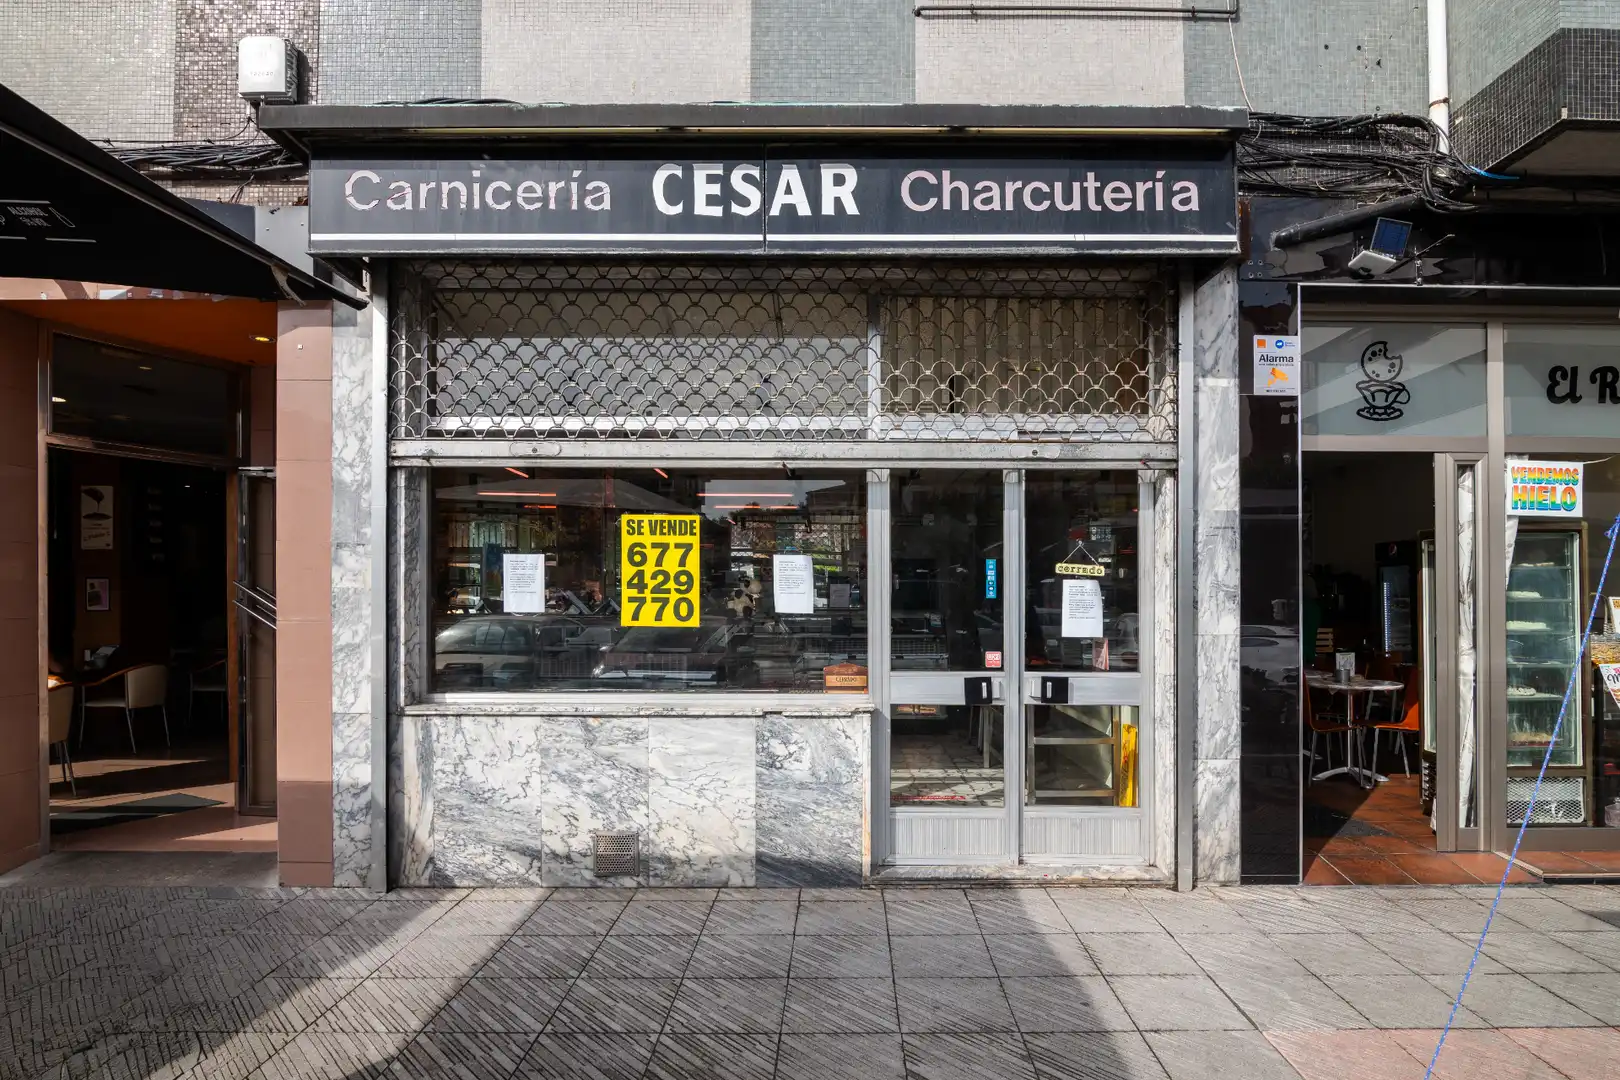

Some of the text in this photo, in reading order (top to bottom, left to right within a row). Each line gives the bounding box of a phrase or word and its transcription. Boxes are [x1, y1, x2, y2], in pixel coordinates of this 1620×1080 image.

[344, 162, 1200, 217] Carnicería CESAR Charcutería
[1258, 353, 1294, 363] Alarma
[1546, 365, 1583, 404] El
[1511, 466, 1579, 486] VENDEMOS
[1511, 485, 1577, 511] HIELO
[626, 519, 697, 536] SE VENDE
[627, 542, 694, 568] 677
[626, 569, 695, 595] 429
[1057, 565, 1103, 575] cerrado
[627, 596, 695, 622] 770
